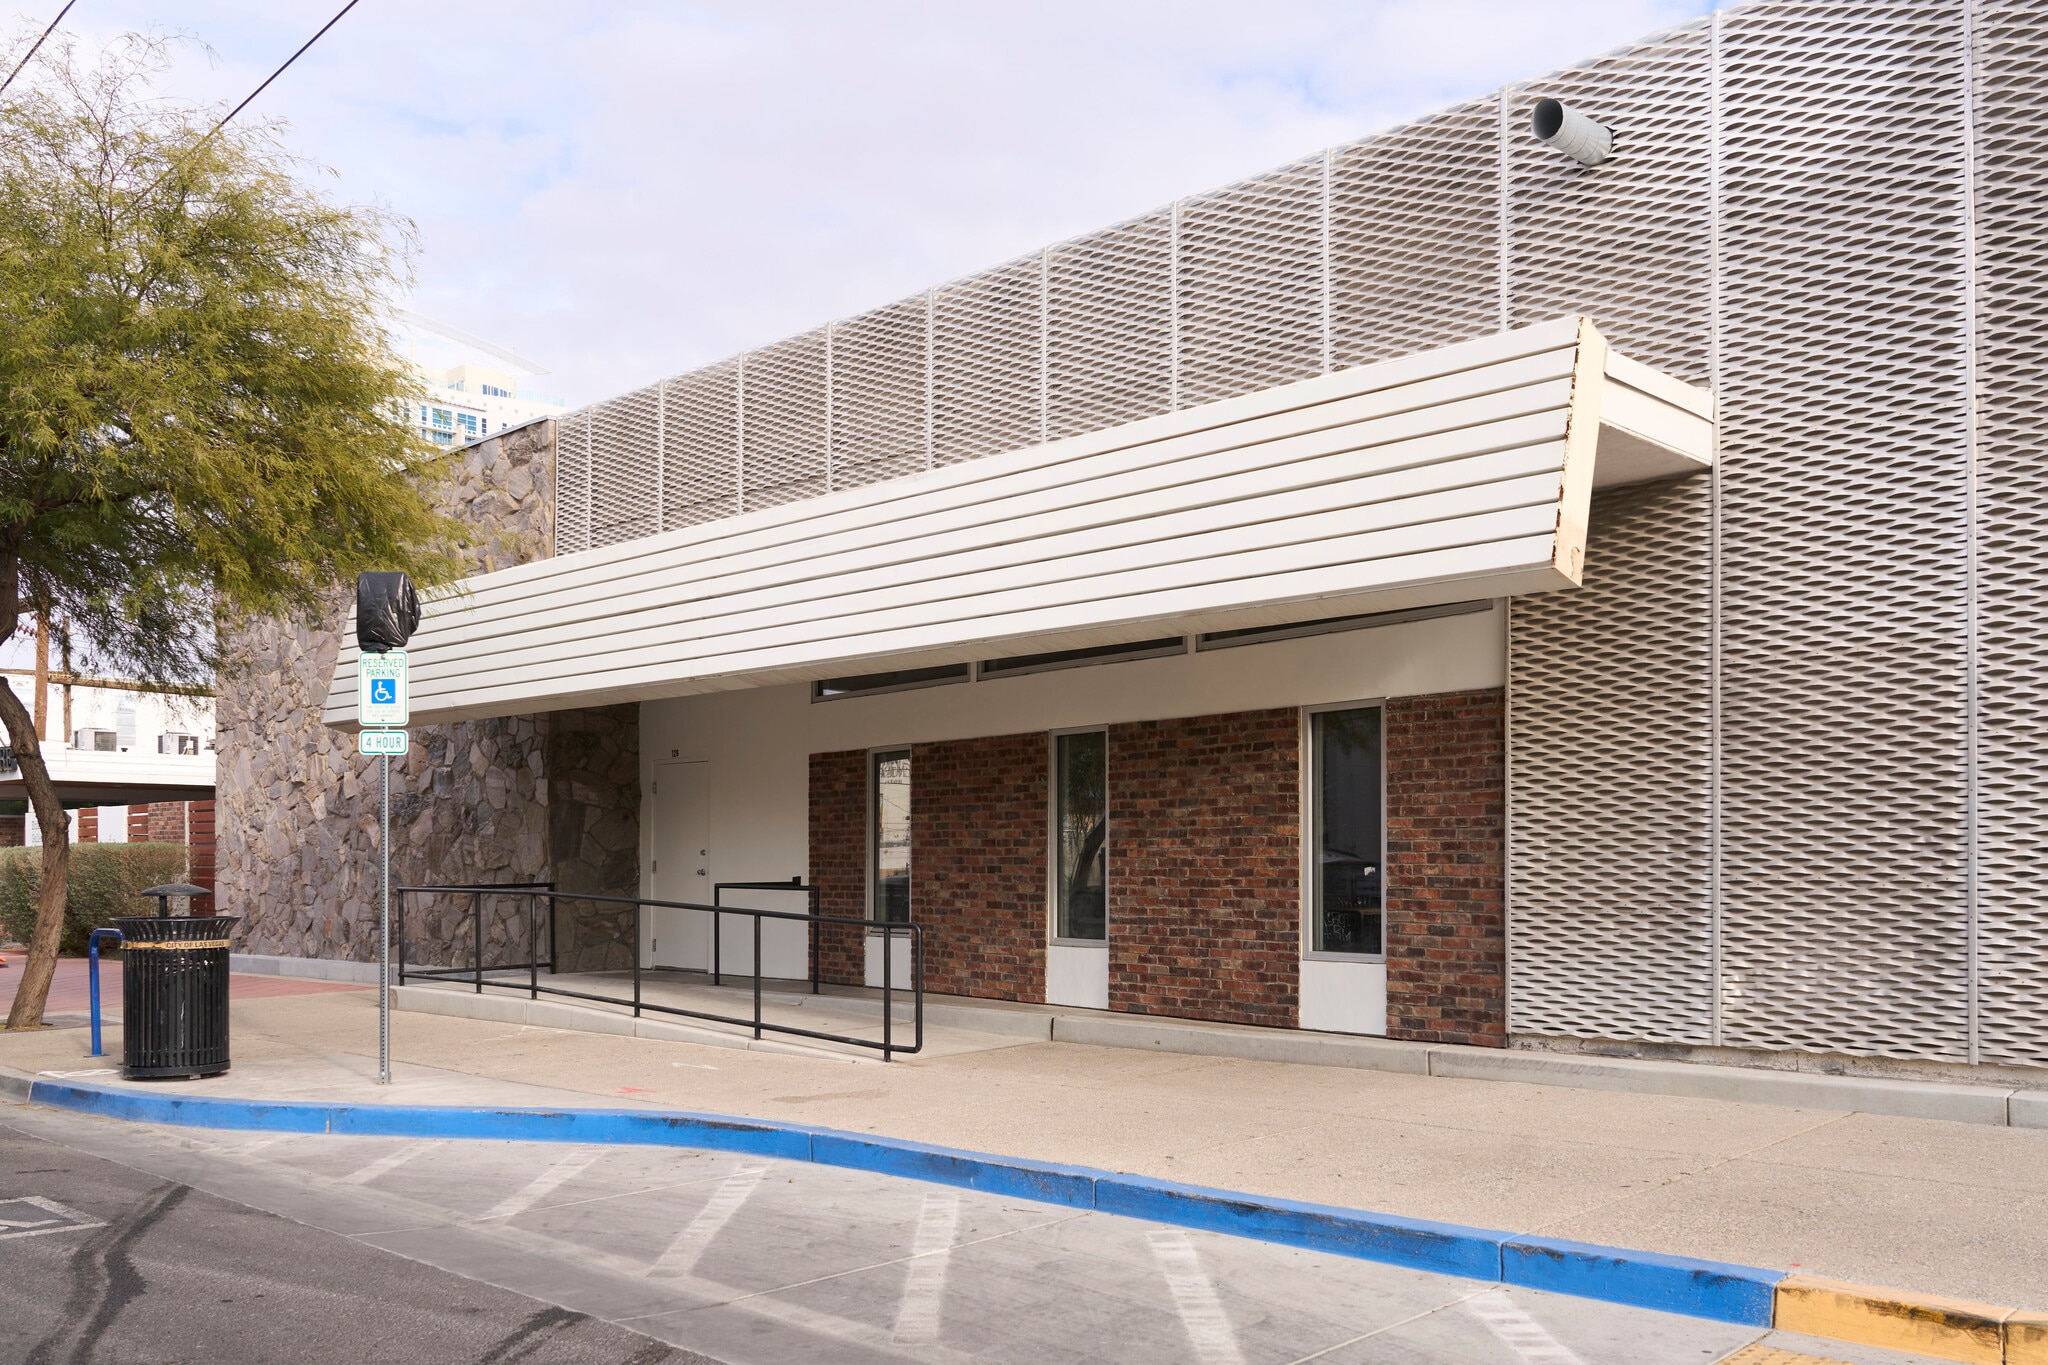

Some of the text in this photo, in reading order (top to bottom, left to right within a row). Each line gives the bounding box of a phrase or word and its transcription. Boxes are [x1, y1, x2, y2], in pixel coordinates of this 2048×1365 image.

[362, 658, 404, 668] RESERVED
[366, 668, 400, 678] PARKING
[366, 736, 401, 748] 4 HOUR
